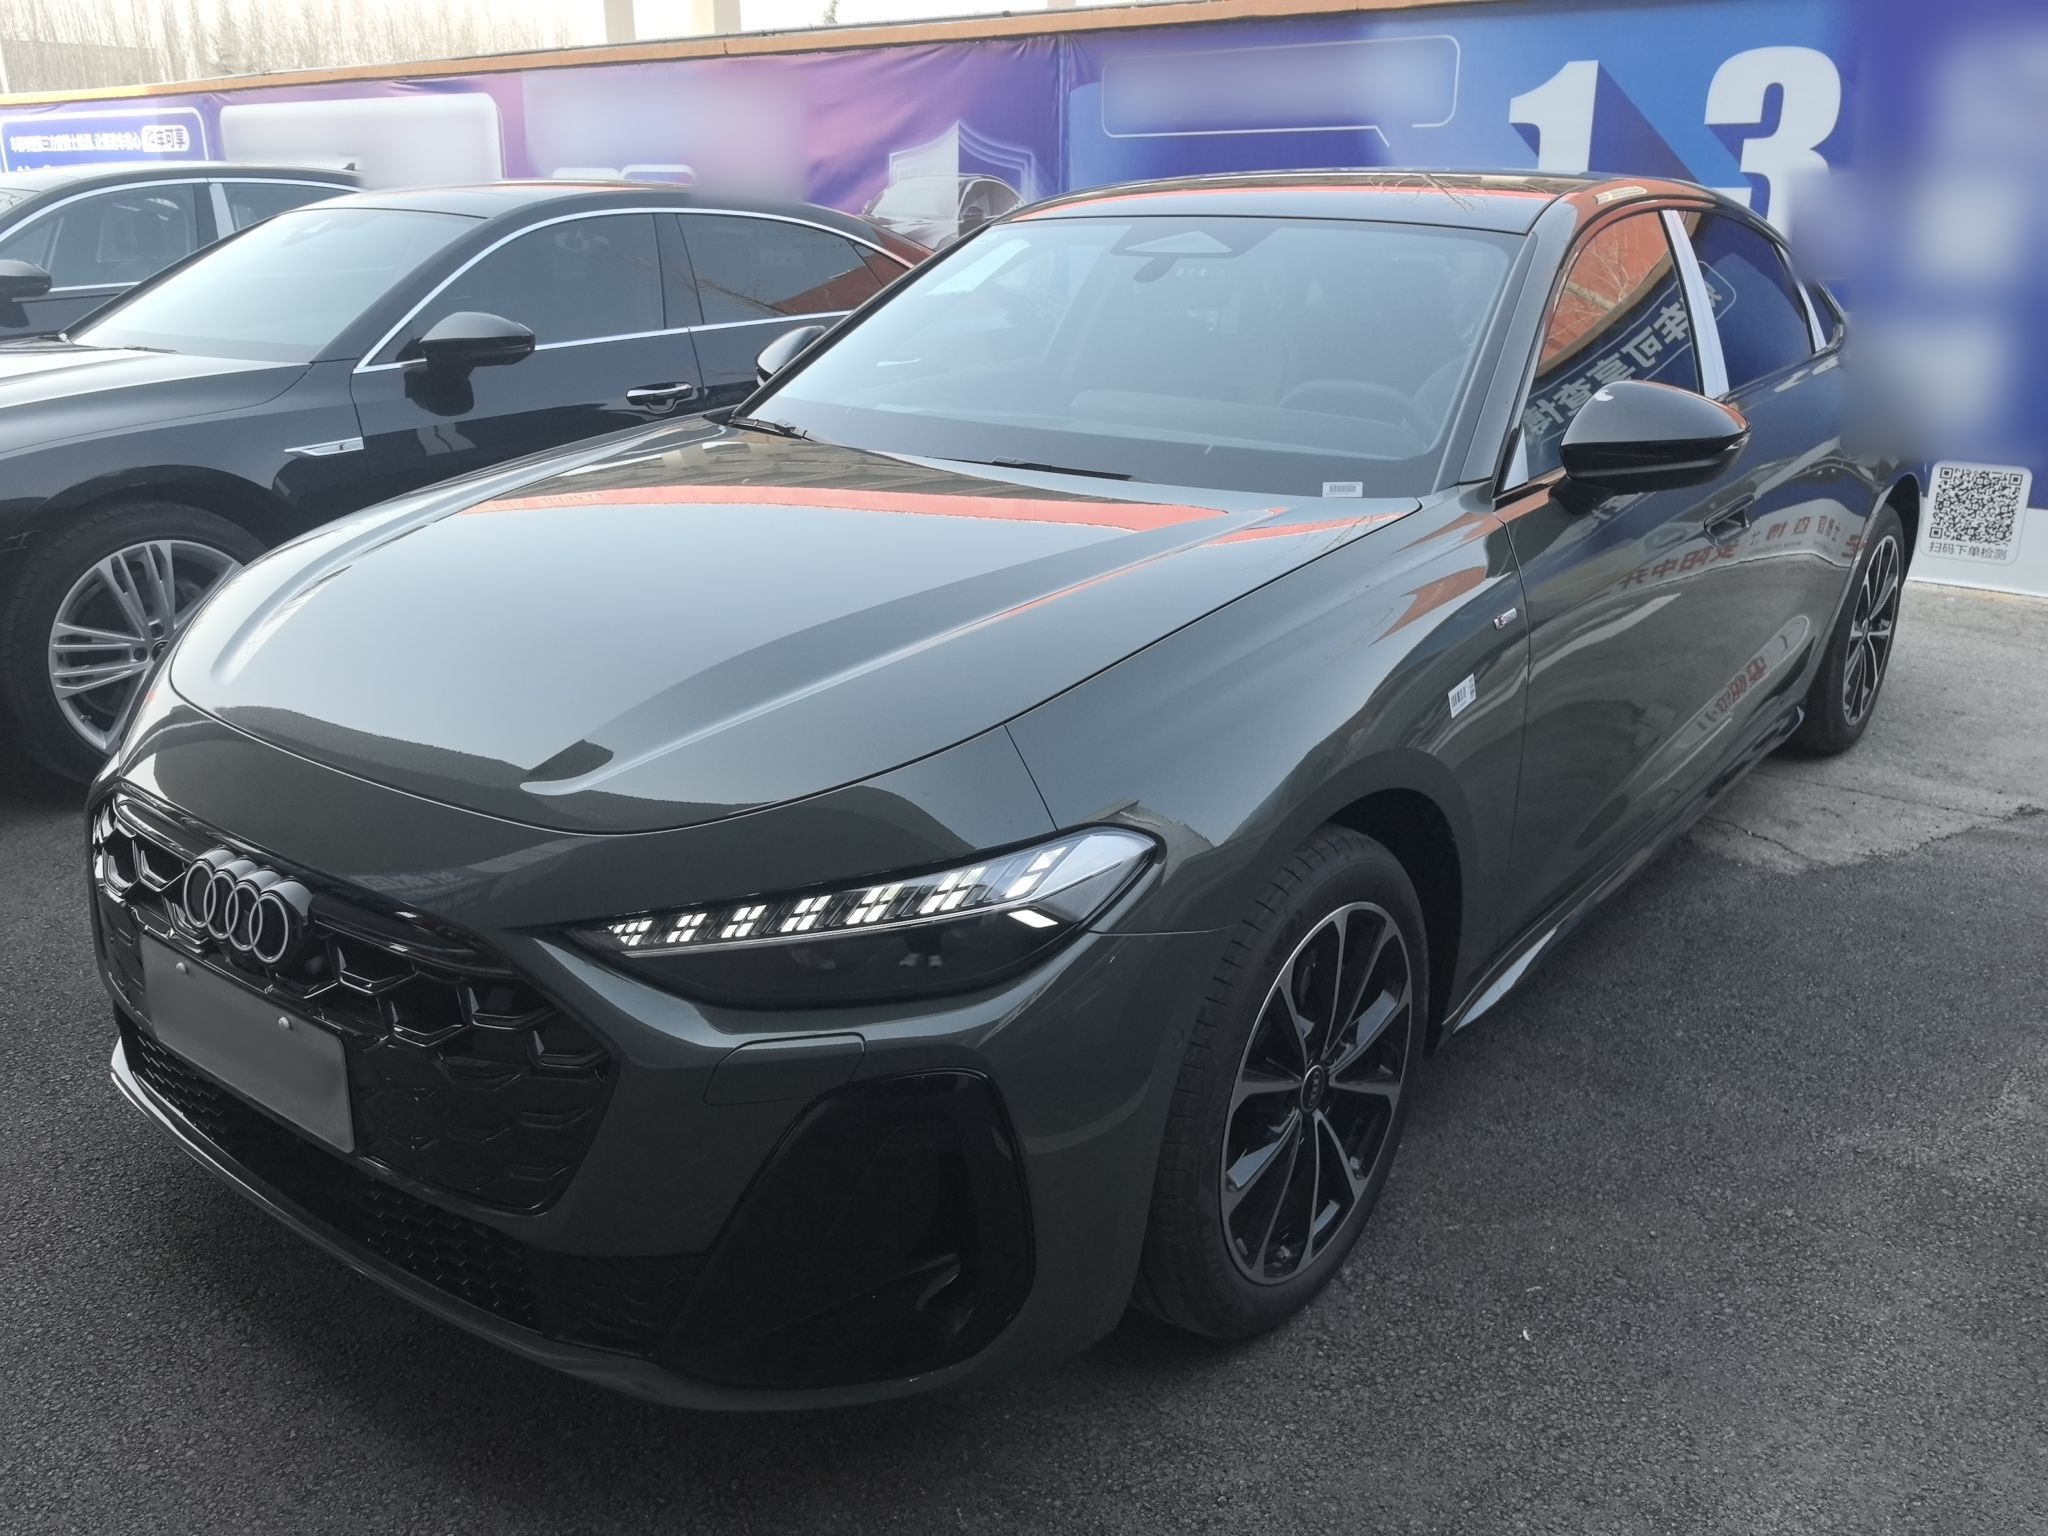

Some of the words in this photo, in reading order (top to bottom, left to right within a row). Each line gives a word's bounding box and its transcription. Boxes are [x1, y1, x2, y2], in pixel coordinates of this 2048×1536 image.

[1928, 541, 2008, 561] 扫码下单检测
